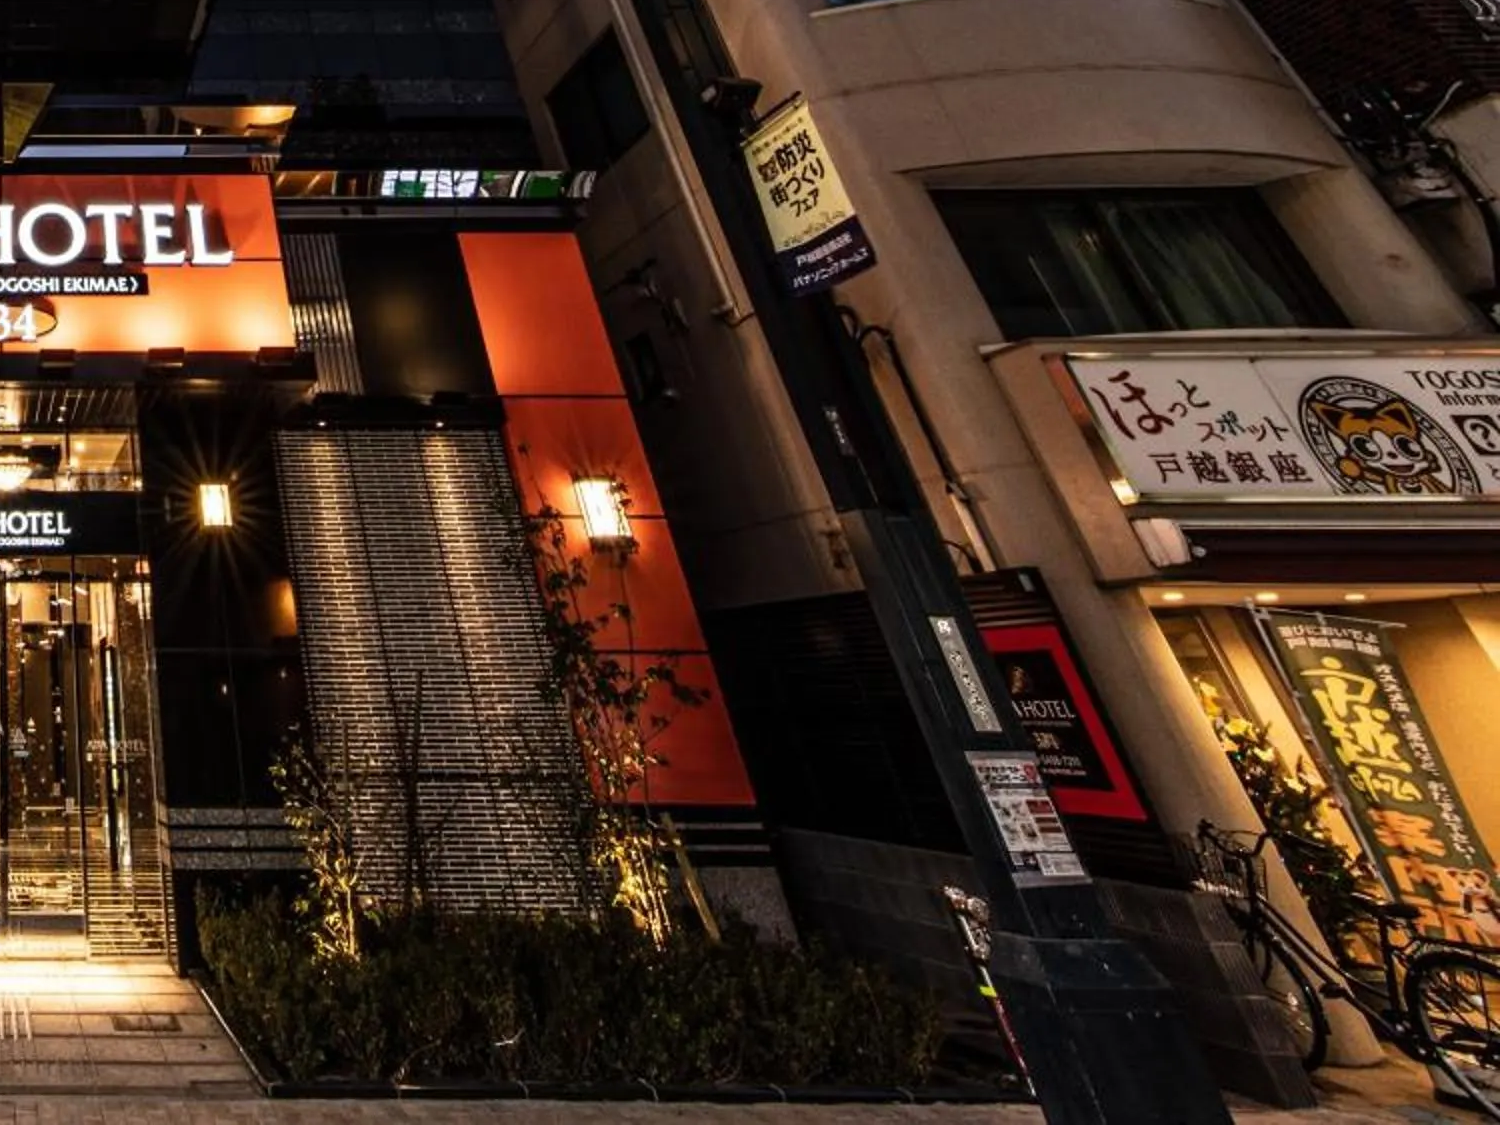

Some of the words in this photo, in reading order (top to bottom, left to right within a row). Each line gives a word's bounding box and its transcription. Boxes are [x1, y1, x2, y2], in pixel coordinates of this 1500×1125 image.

[769, 157, 825, 208] 街づくり
[1403, 370, 1500, 389] TOGOS
[1090, 370, 1212, 440] ほっと
[1435, 390, 1500, 406] Inform
[1199, 411, 1293, 443] スポット
[1149, 450, 1314, 484] 戸越銀座
[1020, 699, 1077, 719] HOTEL
